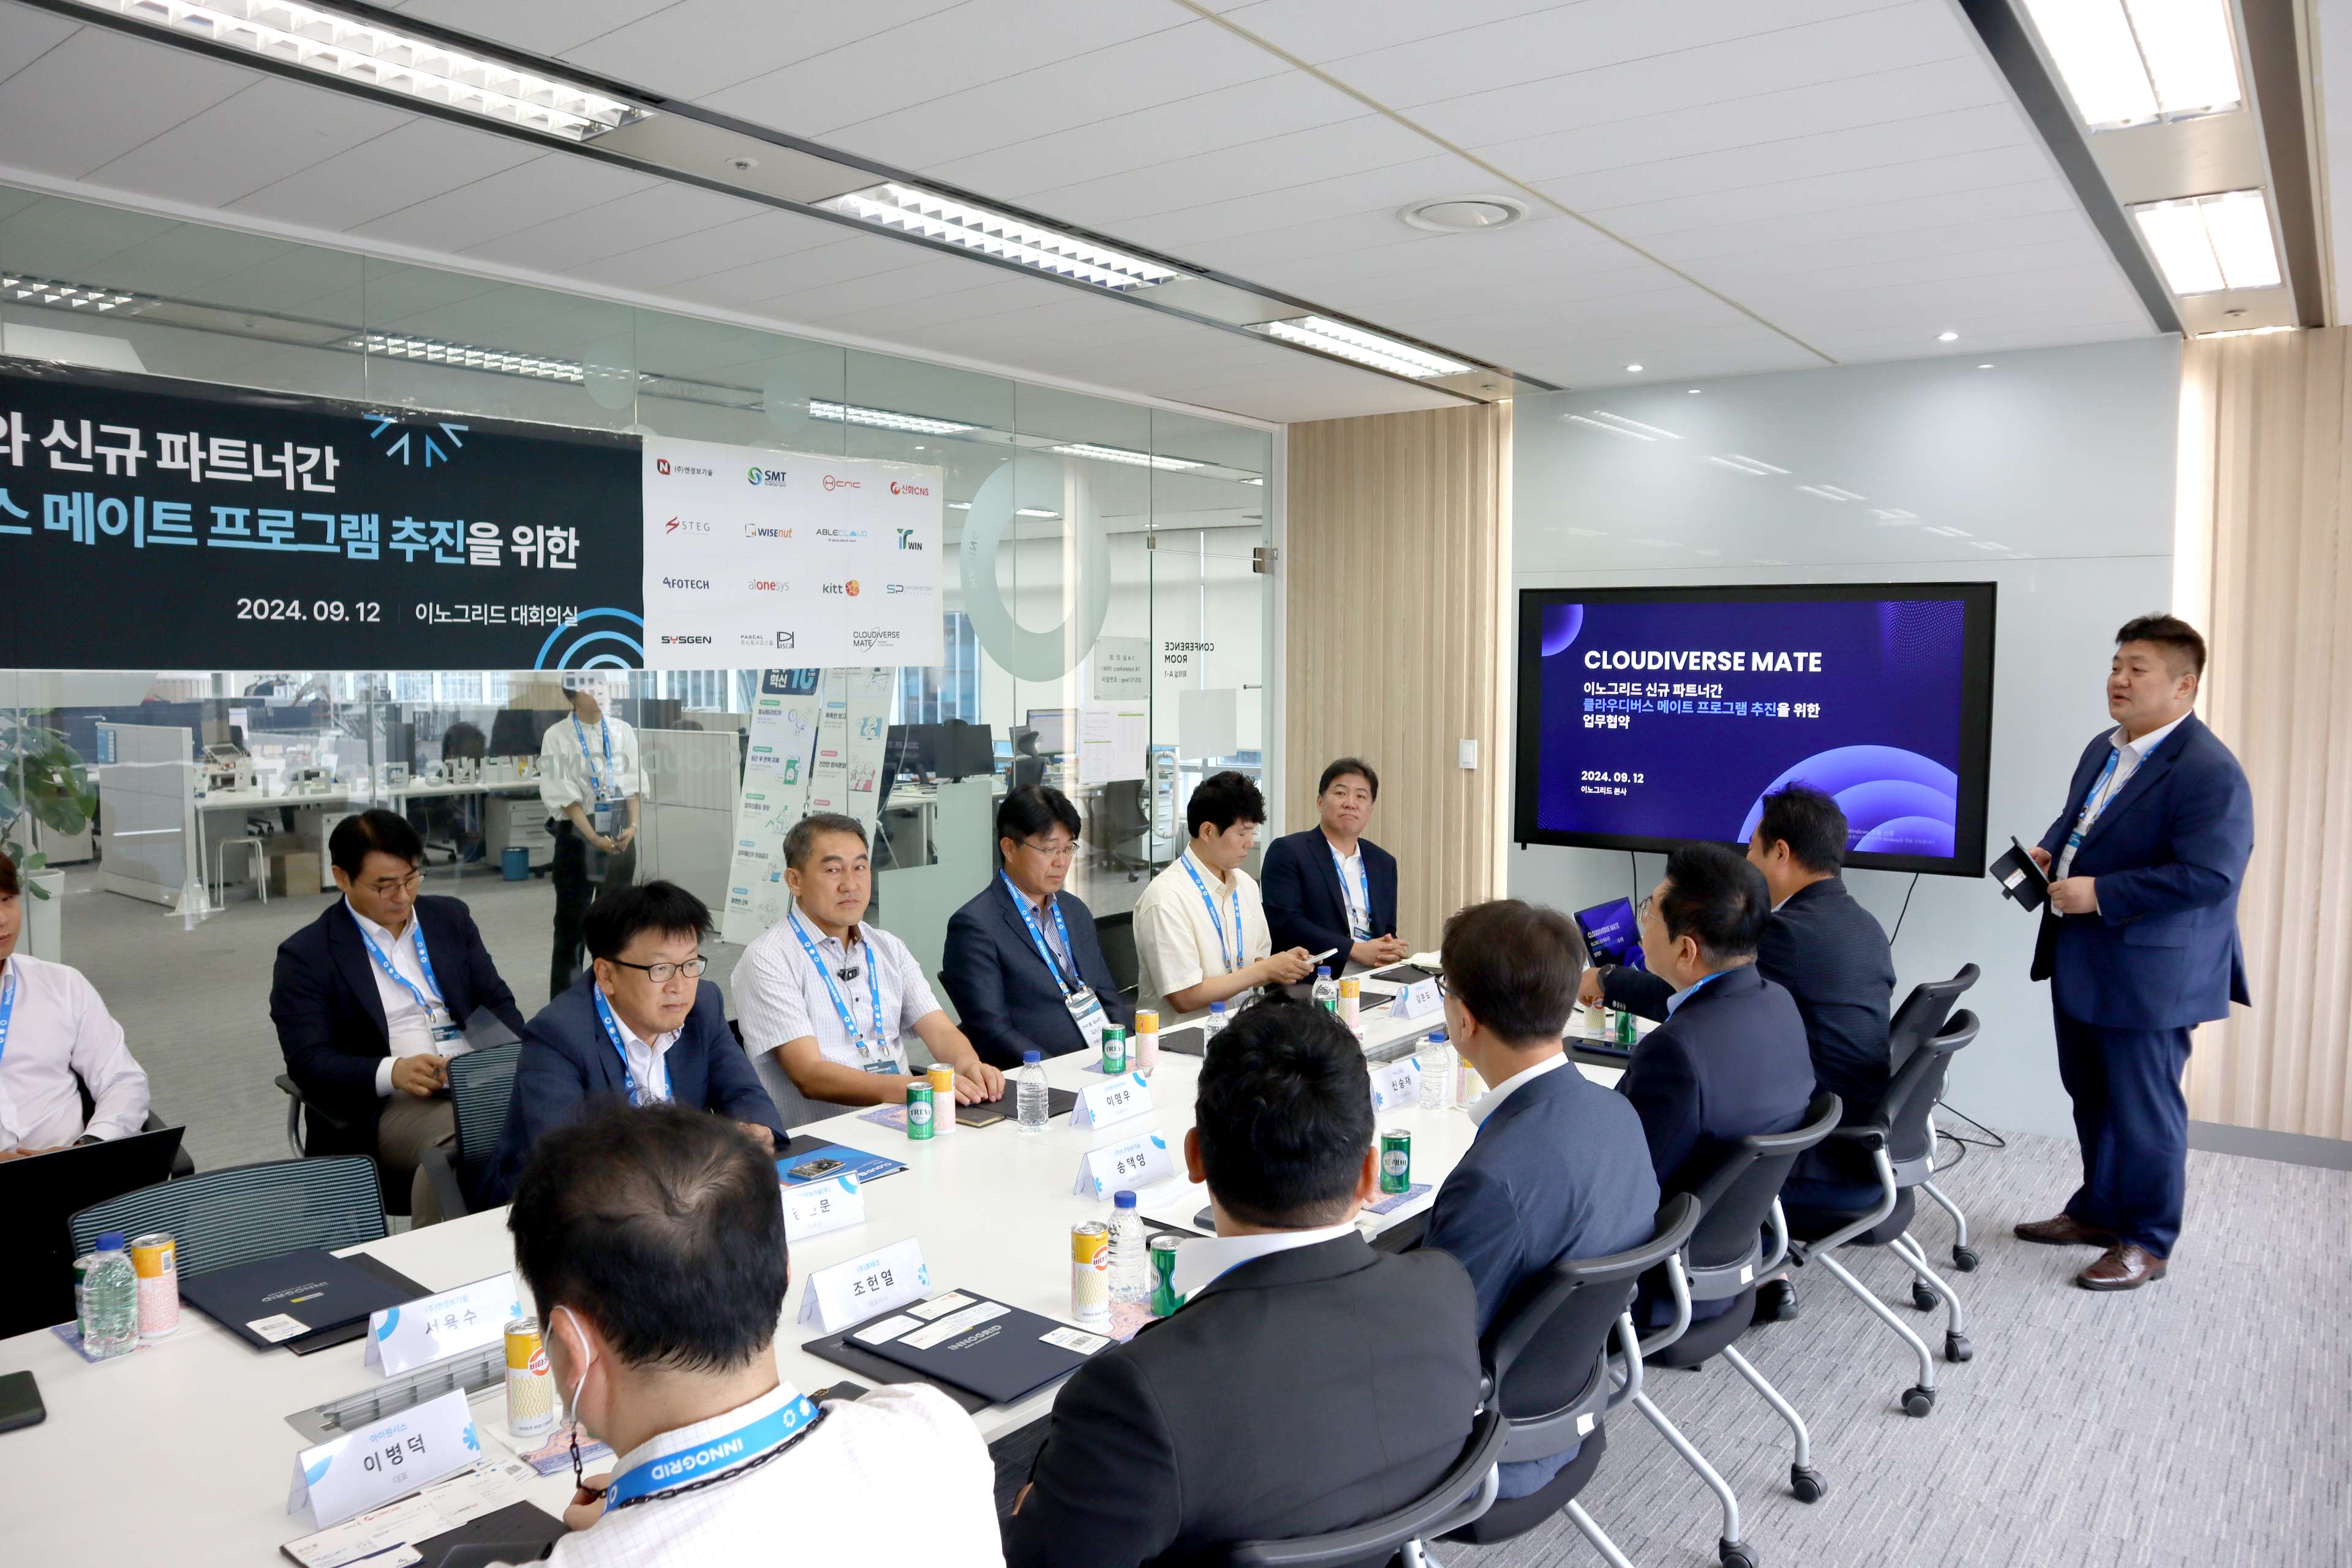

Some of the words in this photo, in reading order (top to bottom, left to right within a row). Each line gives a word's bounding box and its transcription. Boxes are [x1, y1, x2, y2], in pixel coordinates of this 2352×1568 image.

[40, 419, 147, 477] 신규
[156, 435, 339, 493] 파트너간
[765, 470, 786, 481] SMT
[902, 484, 929, 496] 신화CNS
[43, 492, 197, 547] 메이트
[207, 505, 379, 560] 프로그램
[389, 517, 502, 566] 추진을
[510, 524, 579, 569] 위한
[682, 521, 710, 531] STEG
[823, 583, 843, 594] kitt
[887, 584, 903, 594] SP
[237, 598, 307, 620] 2024.
[313, 601, 350, 621] 09.
[356, 602, 380, 622] 12
[415, 602, 507, 624] 이노그리드
[510, 605, 578, 627] 대회의실
[1585, 650, 1745, 671] CLOUDIVERSE
[1752, 652, 1822, 672] MATE
[770, 674, 787, 688] 혁신
[1584, 682, 1642, 696] 이노그리드
[1646, 683, 1670, 697] 신규
[1673, 683, 1723, 698] 파트너간
[1583, 698, 1654, 713] 클라우디버스
[1657, 699, 1694, 714] 메이트
[1697, 701, 1747, 716] 프로그램
[1751, 702, 1790, 717] 추진을
[1793, 703, 1820, 718] 위한
[1583, 714, 1629, 729] 업무협약
[1581, 771, 1611, 782] 2024.
[1614, 772, 1630, 783] 09.
[1634, 773, 1644, 783] 12
[1581, 786, 1612, 794] 이노그리드
[1614, 787, 1627, 796] 본사
[1038, 940, 1050, 963] INNOGRID
[825, 975, 840, 1003] INNOGRID
[1106, 1090, 1130, 1106] 이영우
[910, 1108, 930, 1117] TREVI
[1117, 1153, 1145, 1174] 송택영
[853, 1269, 894, 1297] 조헌열
[426, 1309, 477, 1335] 서용수
[948, 1325, 1002, 1351] INNOGRID
[369, 1423, 408, 1442] 아이원시스
[364, 1433, 425, 1472] 이병덕
[652, 1438, 743, 1480] INNOGRID
[393, 1472, 409, 1483] 대표
